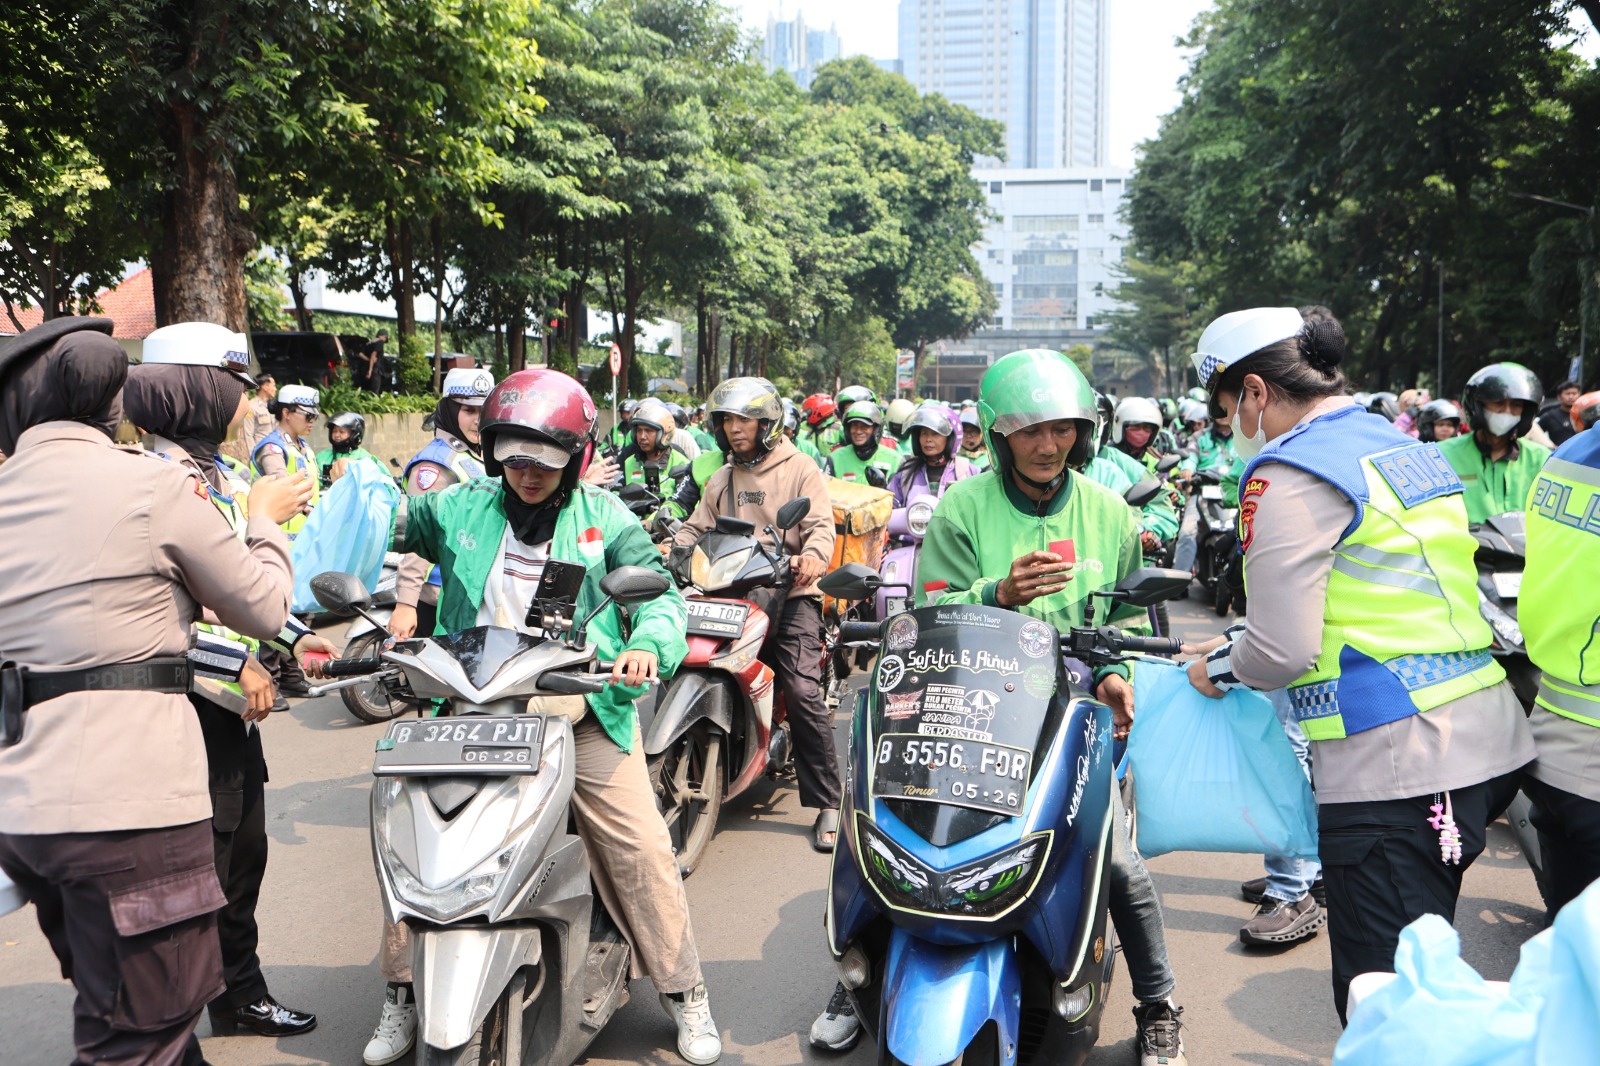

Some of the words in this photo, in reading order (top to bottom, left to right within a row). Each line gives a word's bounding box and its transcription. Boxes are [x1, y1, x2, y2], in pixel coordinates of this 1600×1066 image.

[719, 607, 742, 620] TOP
[907, 648, 957, 669] Safitri
[973, 650, 1019, 672] Ainun
[927, 686, 941, 694] KAMI
[941, 687, 965, 695] PECINTA
[925, 695, 941, 704] KILO
[941, 696, 965, 706] METER
[923, 702, 945, 711] BUKAN
[945, 703, 971, 714] PECINTA
[922, 712, 962, 725] JANDA
[397, 726, 412, 743] B
[424, 723, 482, 742] 3264
[492, 722, 537, 742] PJT
[879, 740, 893, 764] B
[904, 740, 964, 769] 5556
[980, 748, 1027, 781] FDR
[903, 785, 939, 796] Timur
[528, 860, 556, 904] HONDA
